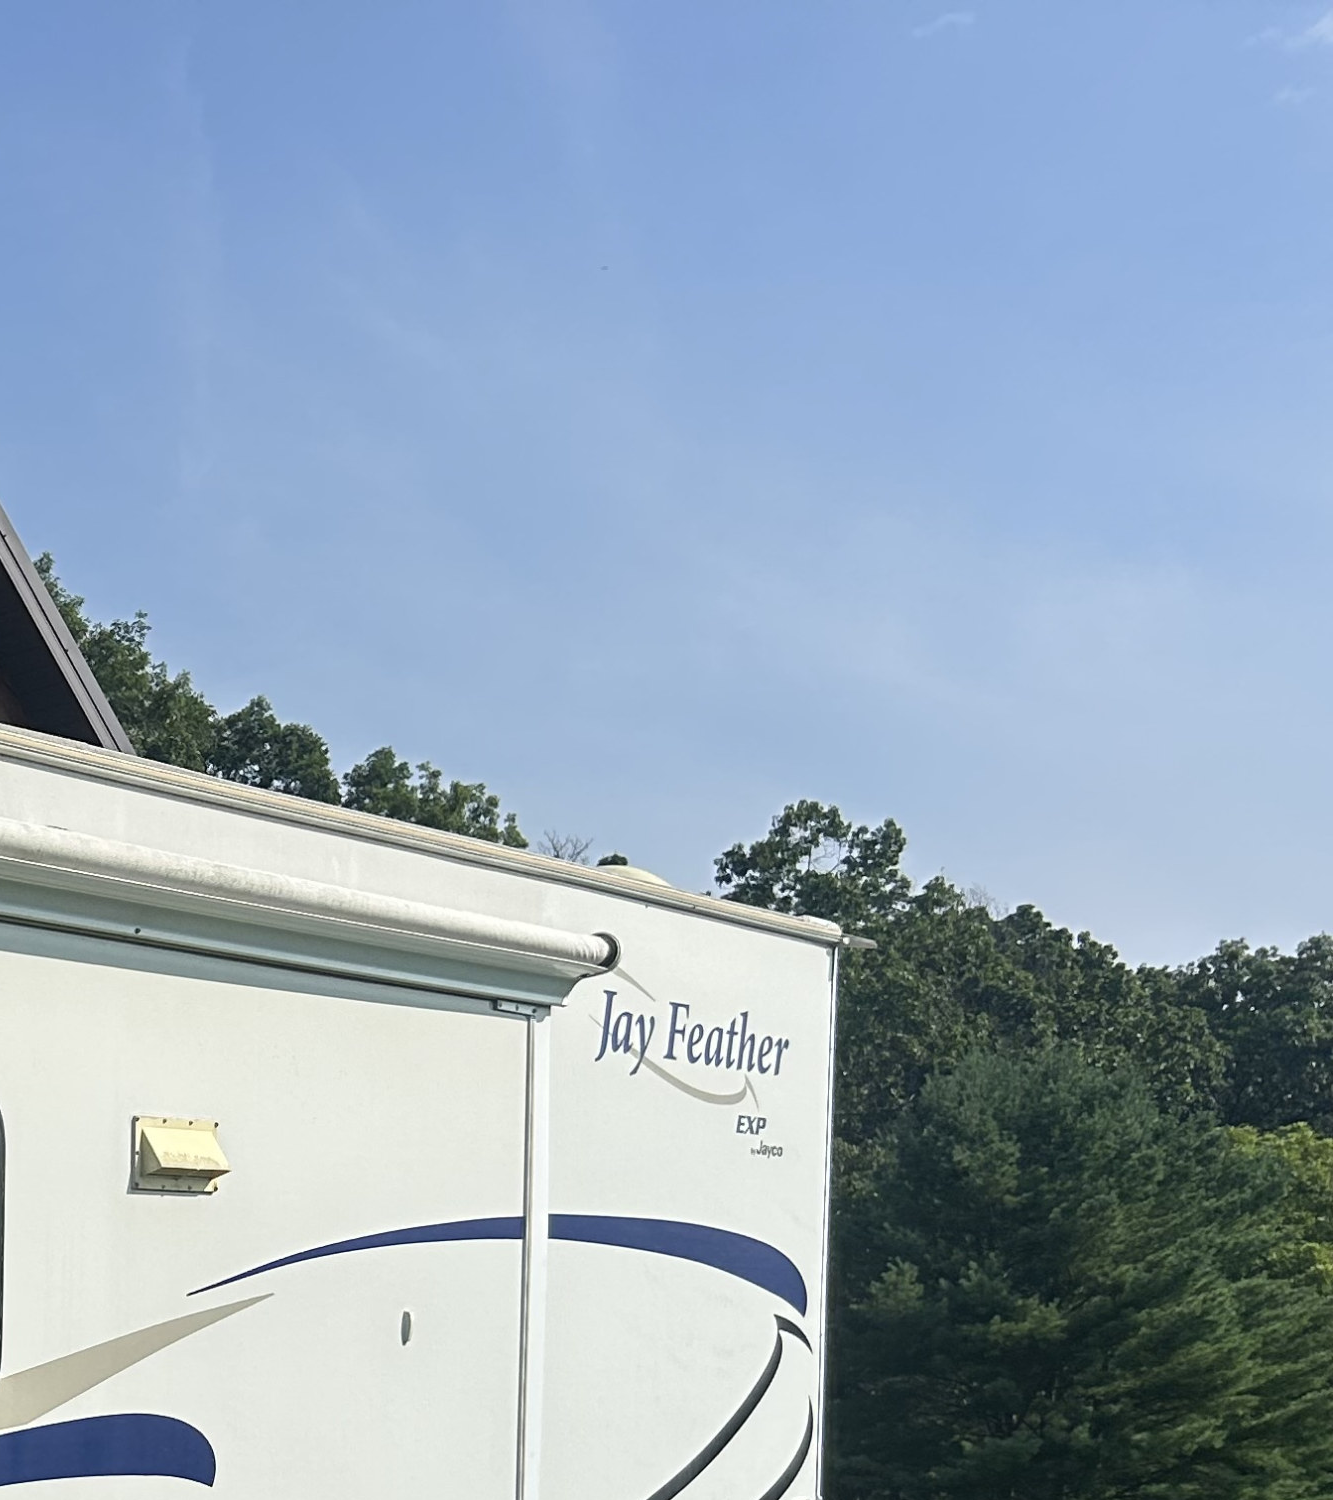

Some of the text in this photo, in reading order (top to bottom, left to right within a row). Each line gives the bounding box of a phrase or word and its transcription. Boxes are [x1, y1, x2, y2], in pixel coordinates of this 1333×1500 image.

[594, 989, 790, 1076] Jay Feather
[735, 1114, 767, 1136] EXP
[756, 1139, 783, 1159] Jayco
